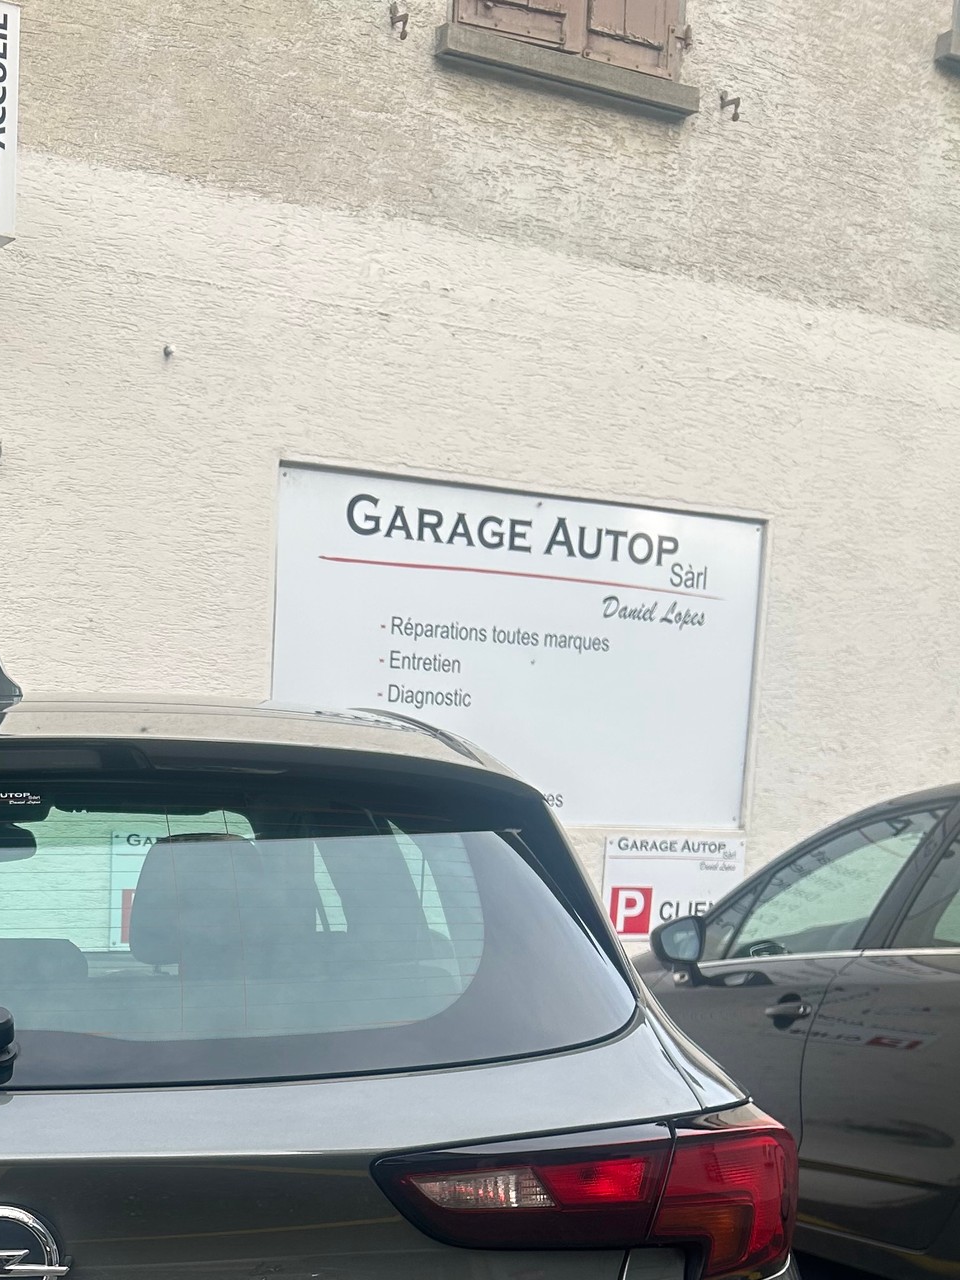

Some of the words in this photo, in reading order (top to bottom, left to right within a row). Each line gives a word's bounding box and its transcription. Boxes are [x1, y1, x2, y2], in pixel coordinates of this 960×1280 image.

[345, 493, 532, 553] GARAGE
[543, 517, 680, 566] AUTOP
[670, 562, 707, 590] Sàrl
[601, 595, 657, 624] Daniel
[659, 601, 706, 630] Lopes
[390, 616, 488, 645] Réparations
[492, 626, 539, 647] toutes
[543, 633, 610, 654] marques
[389, 651, 461, 674] Entretien
[387, 684, 472, 708] Diagnostic
[617, 836, 678, 852] GARAGE
[681, 838, 726, 854] AUTOP
[615, 890, 645, 933] P
